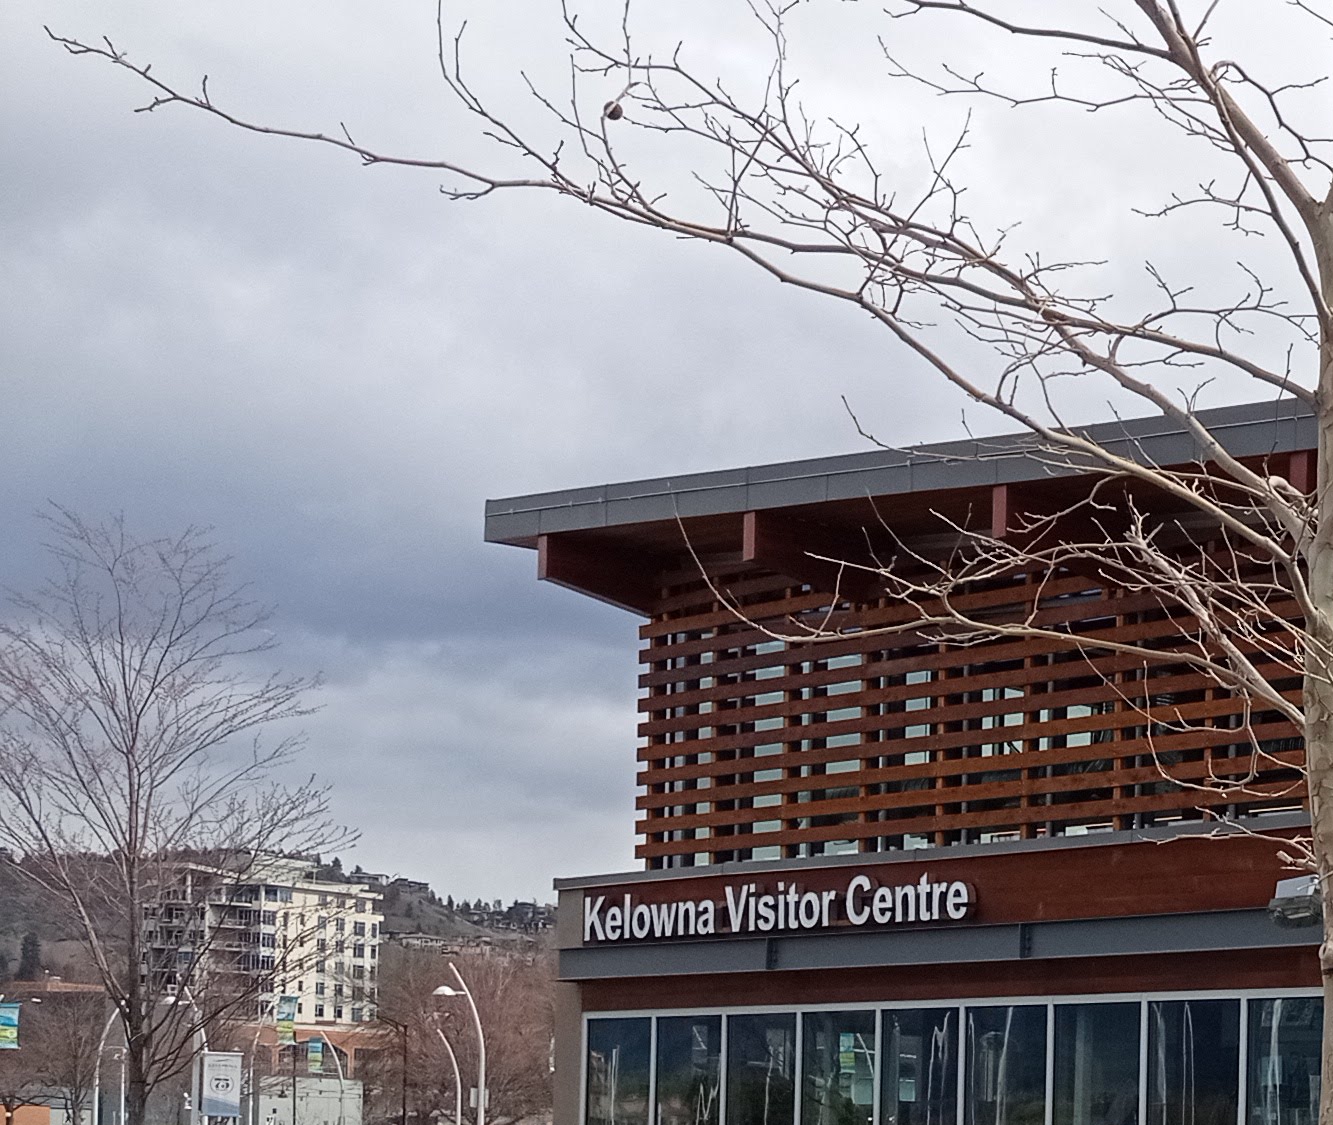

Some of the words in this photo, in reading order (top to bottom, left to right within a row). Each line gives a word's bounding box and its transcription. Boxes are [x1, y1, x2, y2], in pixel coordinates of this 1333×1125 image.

[583, 895, 715, 942] Kelowna
[724, 880, 836, 934] Visitor
[845, 872, 971, 926] Centre
